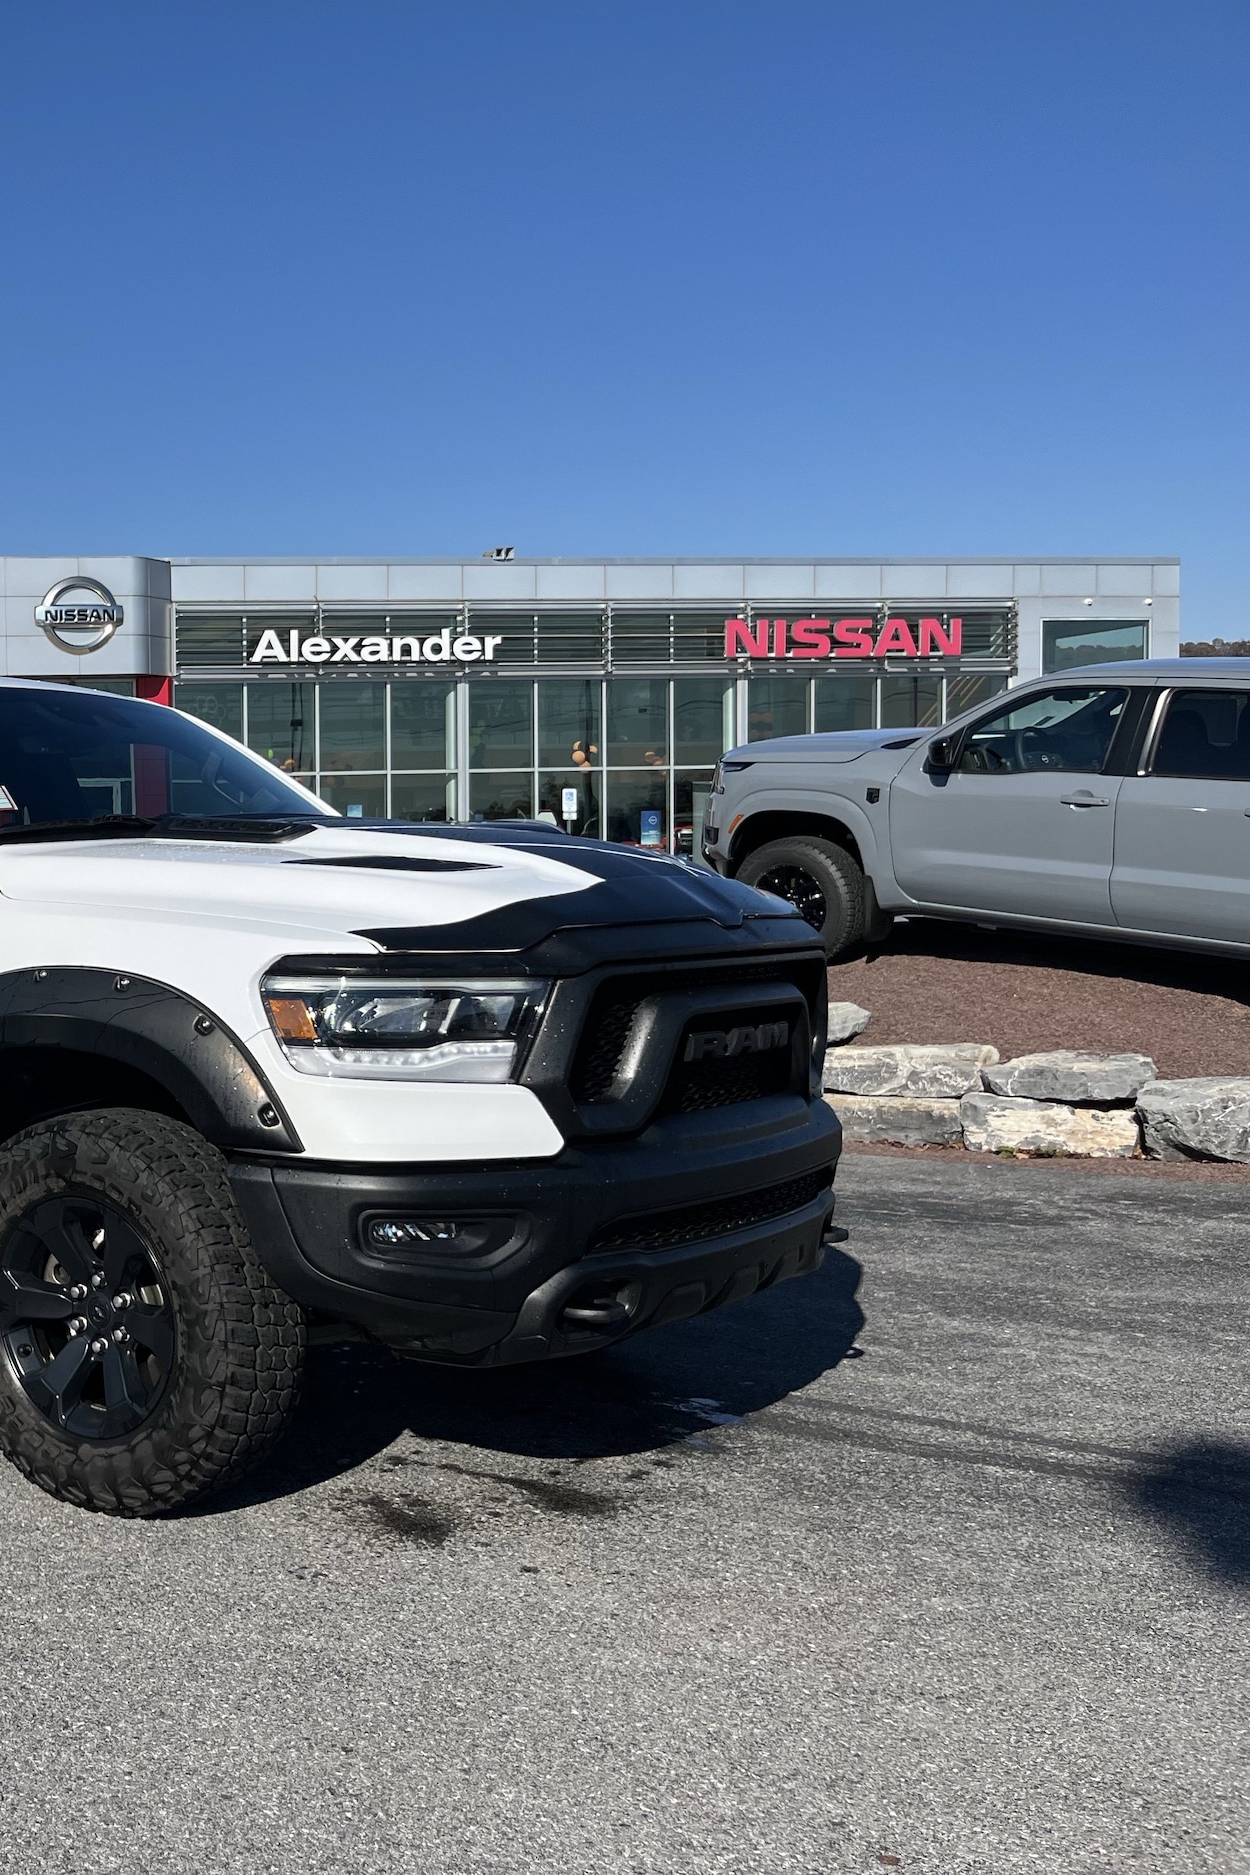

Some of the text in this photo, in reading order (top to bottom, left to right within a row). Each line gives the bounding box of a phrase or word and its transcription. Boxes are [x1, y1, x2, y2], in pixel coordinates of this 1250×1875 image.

[45, 609, 116, 622] NISSAN
[251, 628, 502, 663] Alexander
[724, 618, 962, 658] NISSAN
[684, 1021, 789, 1062] RAM
